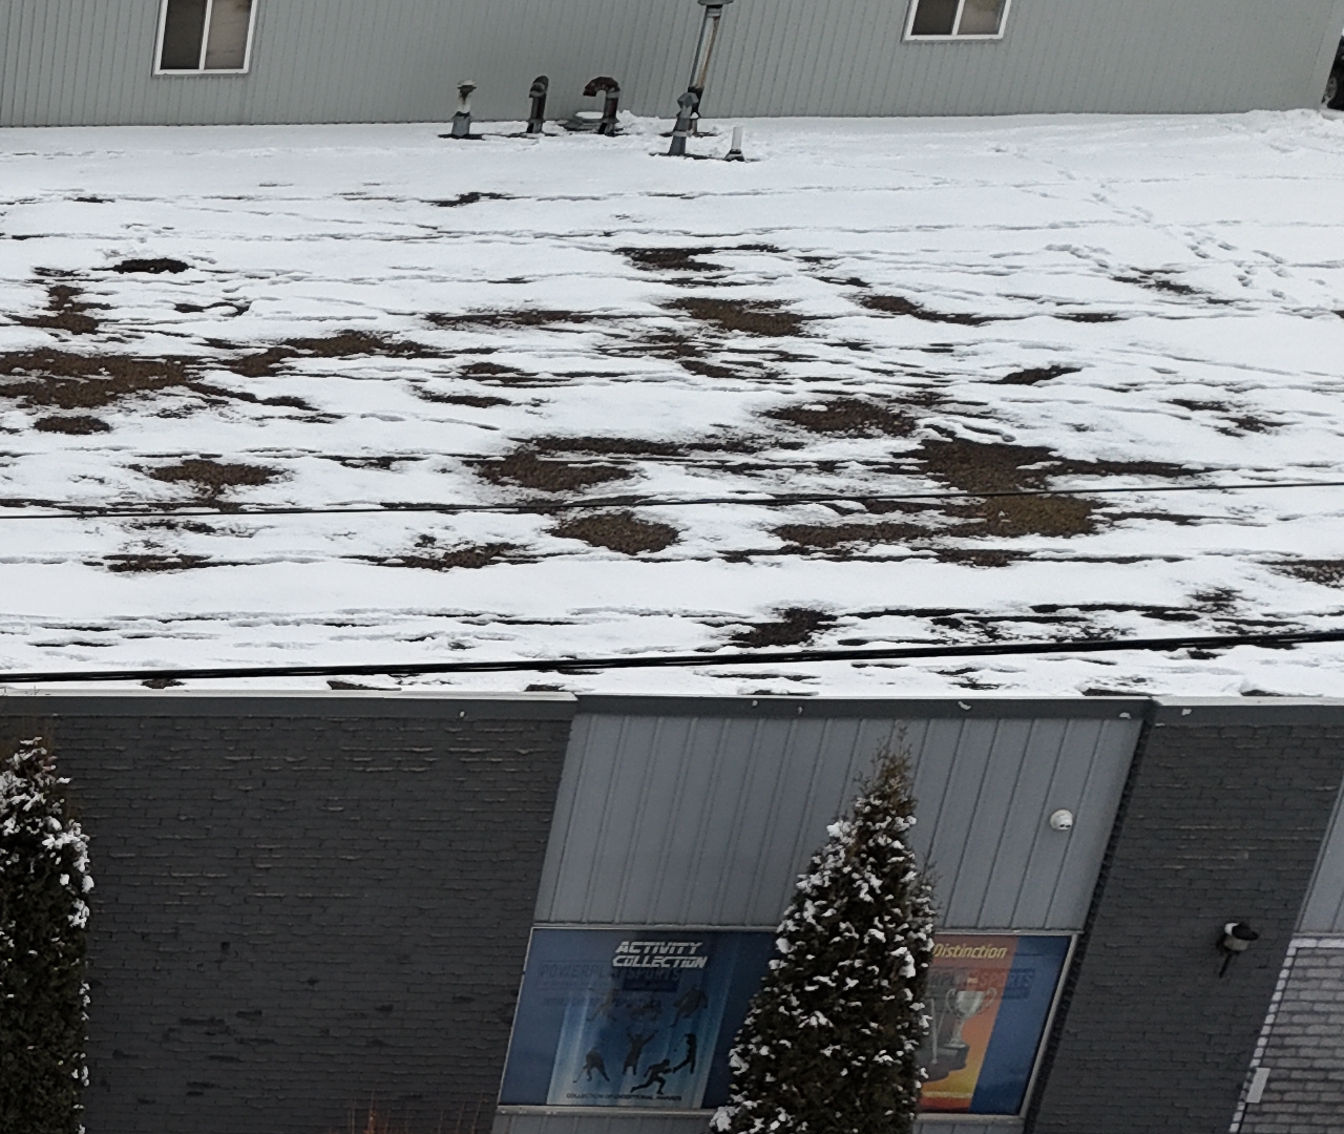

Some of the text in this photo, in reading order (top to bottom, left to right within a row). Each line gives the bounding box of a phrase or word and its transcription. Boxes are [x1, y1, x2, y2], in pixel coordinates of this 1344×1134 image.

[615, 940, 704, 955] ACTIVITY
[932, 943, 1008, 959] Distinction
[612, 955, 708, 968] COLLECTION
